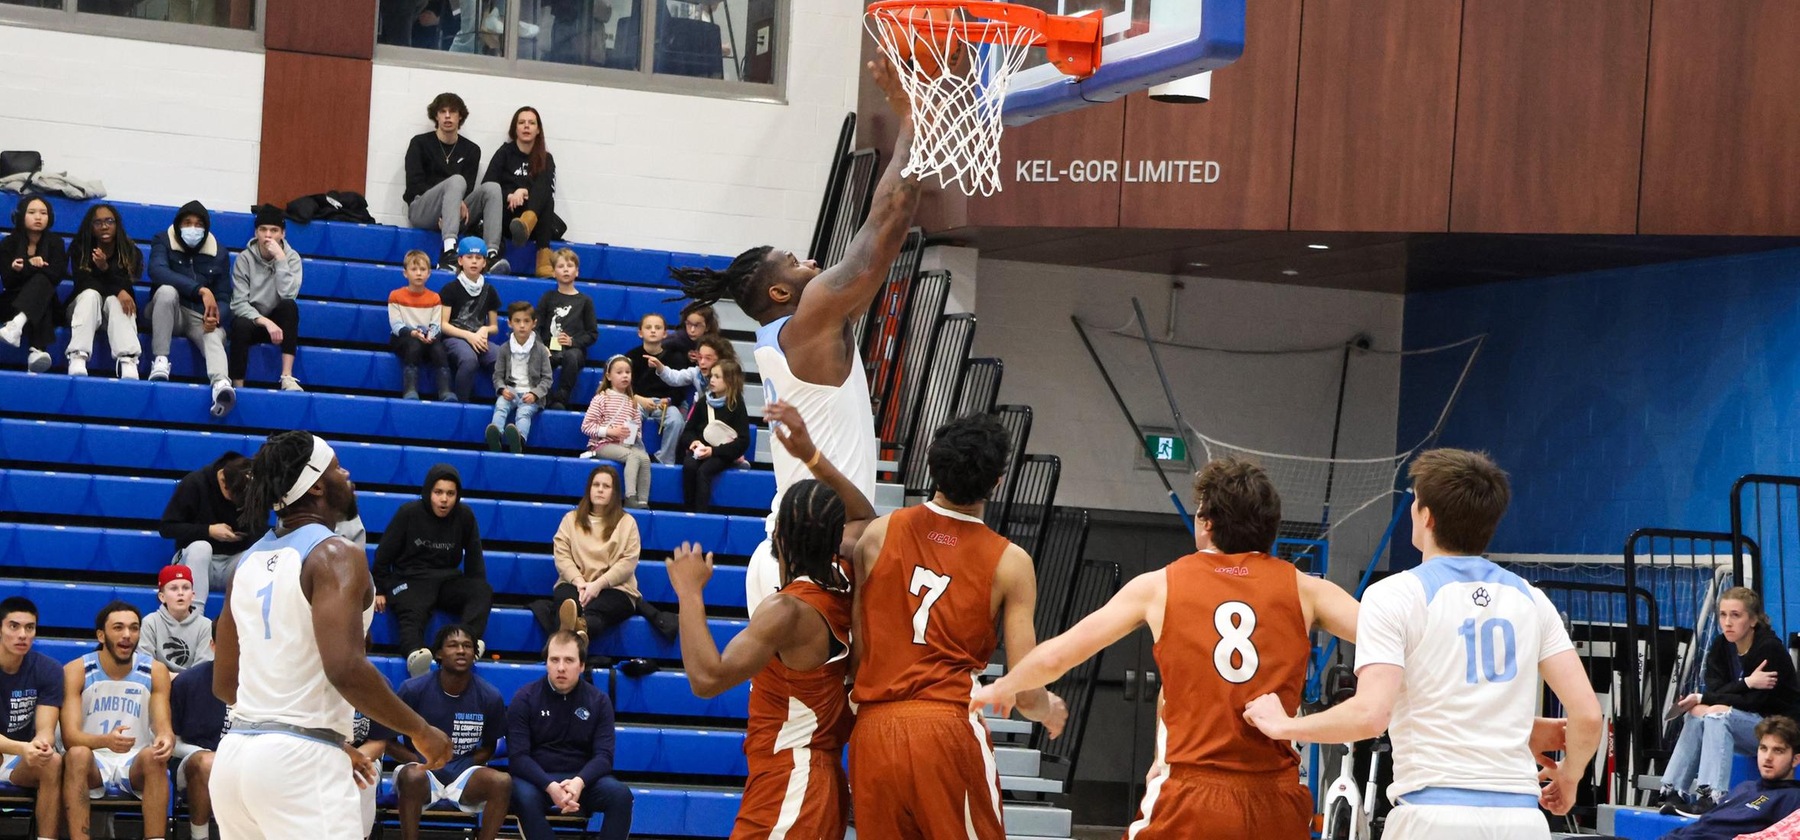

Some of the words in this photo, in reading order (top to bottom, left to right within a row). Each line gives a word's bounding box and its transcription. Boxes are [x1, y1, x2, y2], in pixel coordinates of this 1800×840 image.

[1015, 160, 1118, 182] KEL-GOR
[1124, 160, 1220, 183] LIMITED
[256, 580, 274, 640] 1
[909, 564, 952, 645] 7
[1213, 600, 1260, 685] 8
[1457, 617, 1518, 685] 10
[87, 695, 141, 719] LAMBTON
[455, 712, 465, 720] YOU
[465, 713, 483, 721] MATTER
